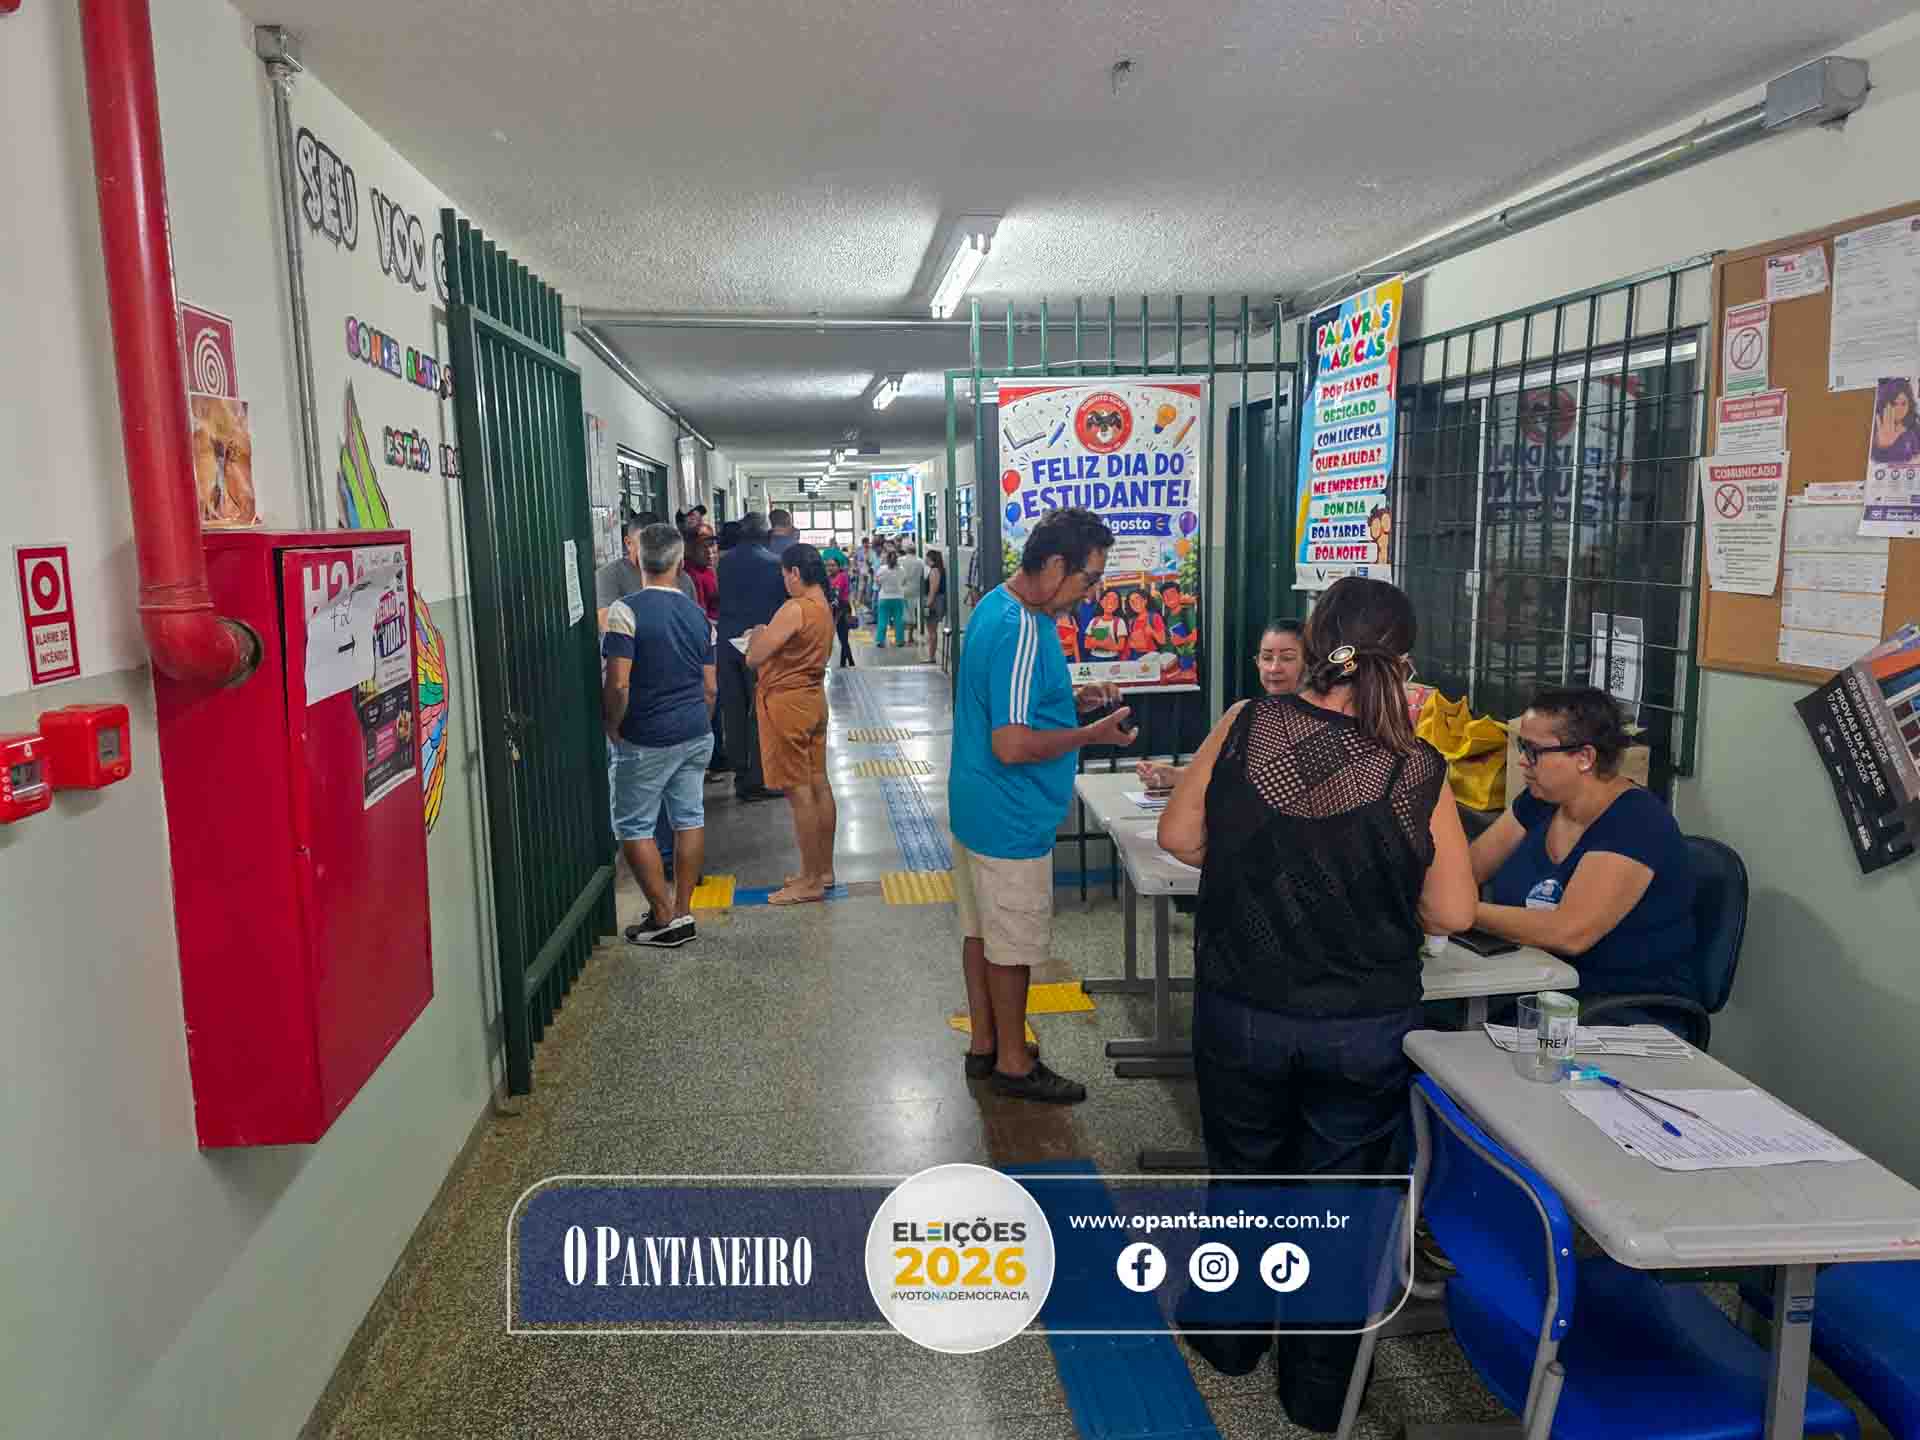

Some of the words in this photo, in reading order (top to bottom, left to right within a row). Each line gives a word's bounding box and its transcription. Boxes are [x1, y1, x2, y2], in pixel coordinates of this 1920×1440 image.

[297, 128, 358, 250] SEU
[1318, 303, 1391, 351] PALAVRAS
[1343, 373, 1379, 393] FAVOR
[1323, 400, 1376, 423] OBRIGADO
[1317, 431, 1337, 447] COM
[1031, 455, 1100, 485] FELIZ
[1107, 453, 1149, 478] DIA
[1155, 452, 1185, 476] DO
[1315, 456, 1340, 471] QUER
[1341, 448, 1382, 467] AJUDA?
[1313, 481, 1326, 495] ME
[1328, 474, 1385, 494] EMPRESTA?
[1022, 480, 1191, 519] ESTUDANTE!
[1324, 502, 1345, 516] BOM
[1346, 501, 1366, 515] DIA
[1312, 525, 1330, 539] BOA
[1333, 524, 1366, 538] TARDE
[1315, 546, 1335, 560] BOA
[1337, 545, 1367, 560] NOITE
[60, 629, 69, 641] DE
[1834, 688, 1858, 732] PROVAS
[1854, 732, 1866, 749] DA
[1868, 762, 1886, 797] FASE:
[1536, 1037, 1568, 1049] TRE-
